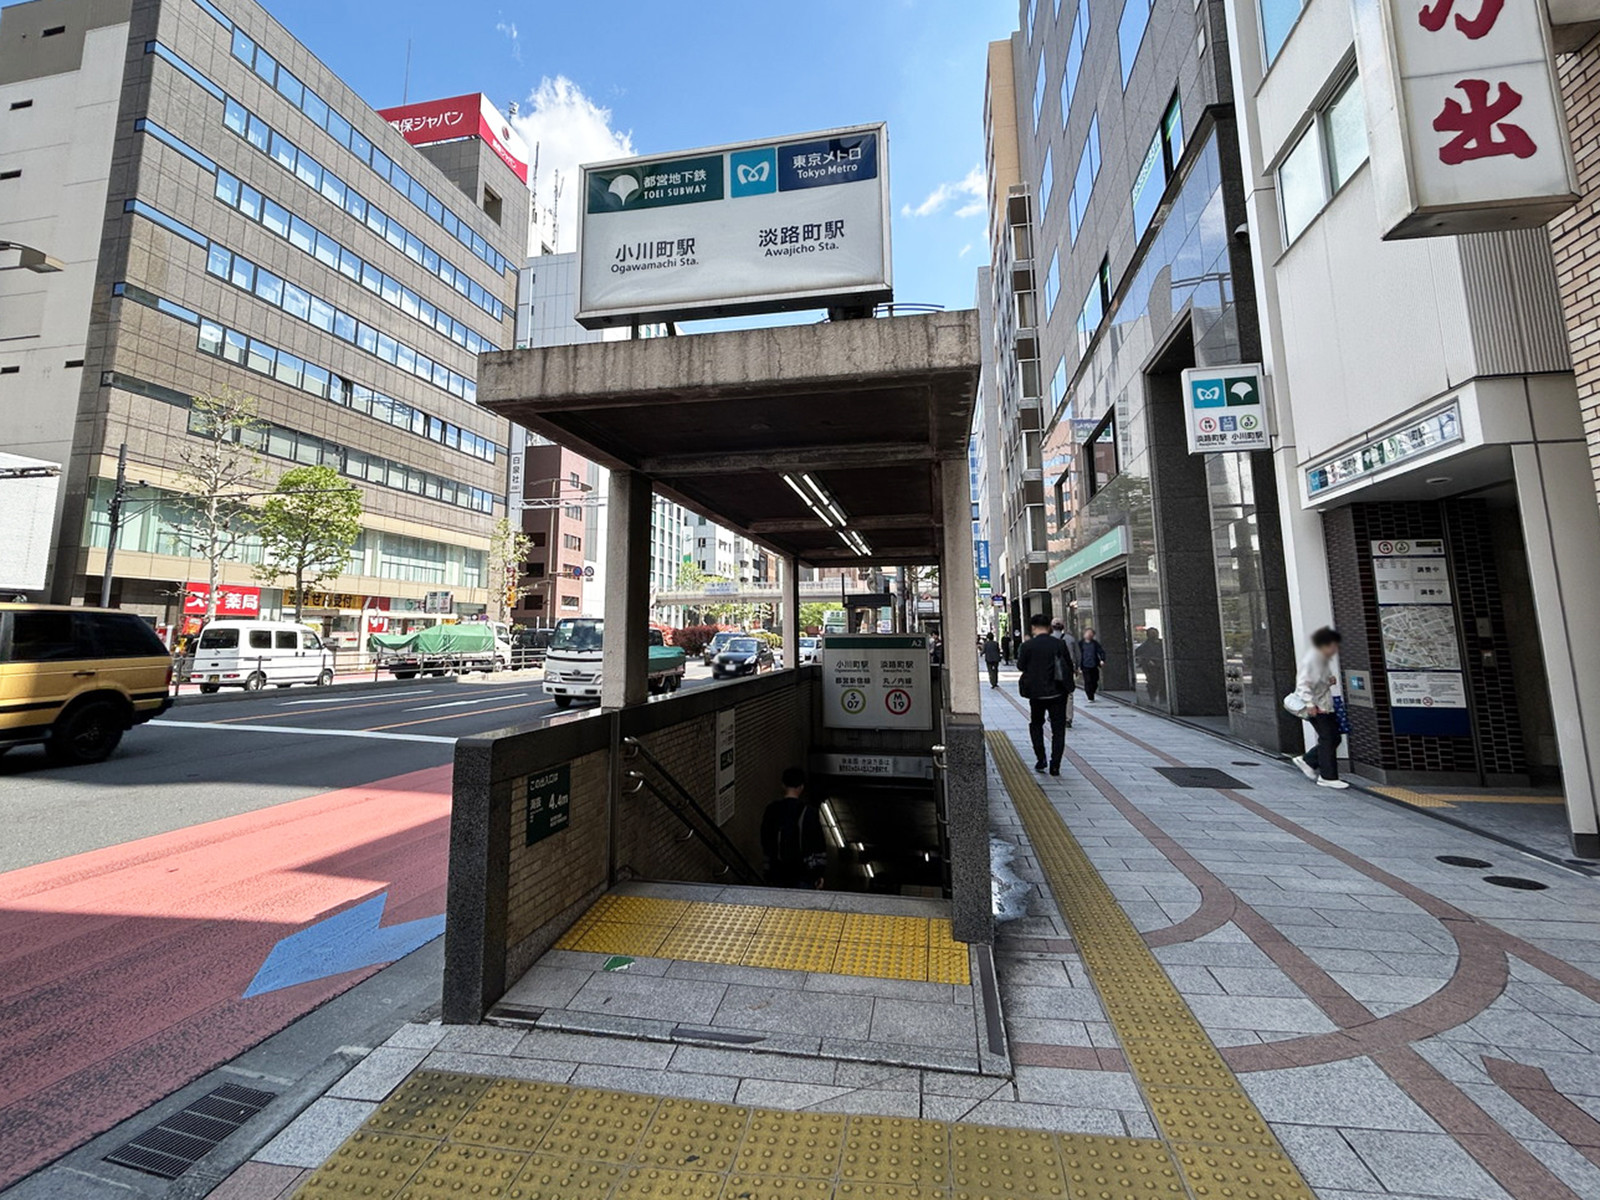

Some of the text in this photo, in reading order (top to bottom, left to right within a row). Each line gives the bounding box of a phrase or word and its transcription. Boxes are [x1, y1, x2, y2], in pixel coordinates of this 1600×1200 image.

[792, 147, 862, 169] 東京メトロ
[643, 169, 707, 188] 都営地下鉄
[797, 163, 858, 179] Tokyo Metro
[643, 184, 707, 200] TOEI SUBWAY
[759, 219, 845, 248] 淡路町駅
[615, 237, 696, 262] 小川町駅
[764, 241, 840, 257] Awajicho Sta.
[610, 257, 700, 275] Ogawamachi Sta.
[1231, 431, 1264, 441] 小川町駅
[836, 660, 869, 669] 小川町駅
[880, 660, 914, 669] 淡路町駅
[850, 692, 856, 700] S
[893, 693, 903, 701] M
[847, 701, 859, 709] 07
[893, 701, 905, 709] 19
